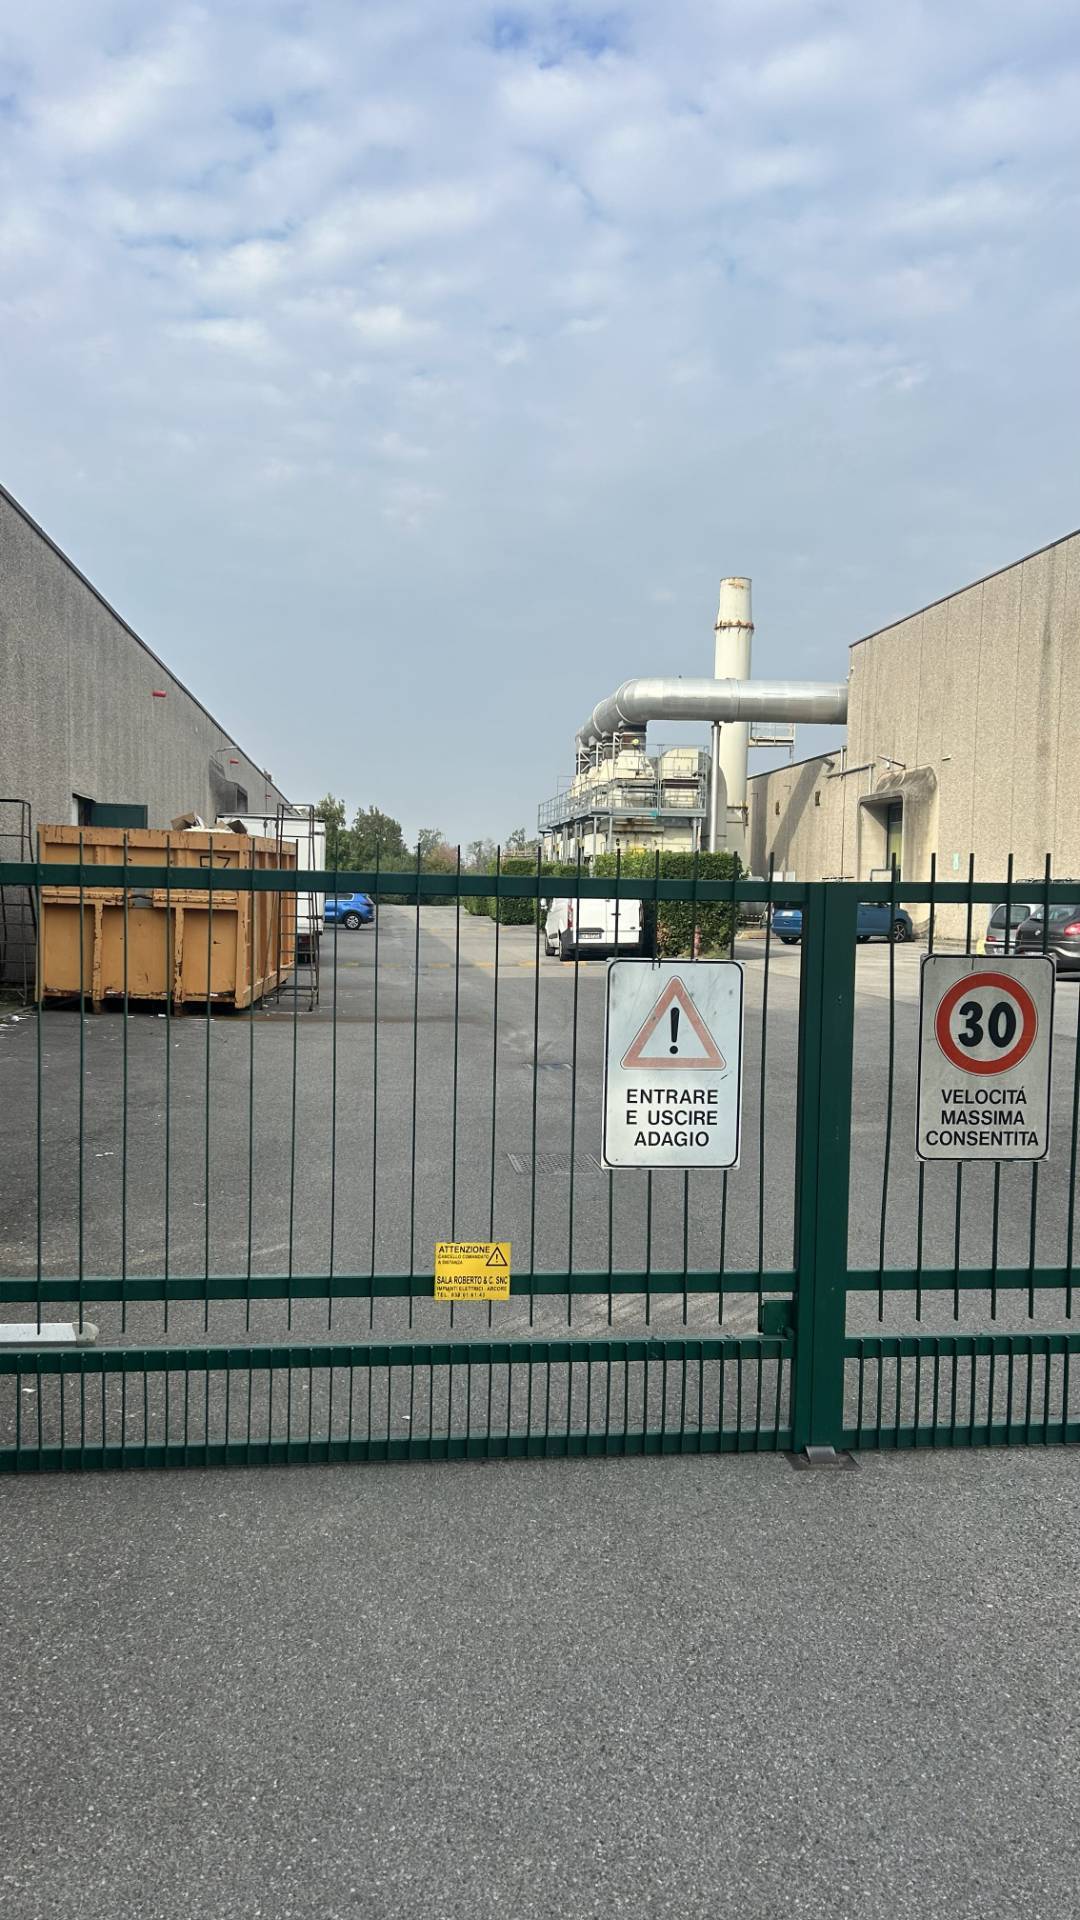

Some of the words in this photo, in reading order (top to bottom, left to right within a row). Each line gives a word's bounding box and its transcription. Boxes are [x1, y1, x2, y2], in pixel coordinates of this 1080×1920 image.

[957, 1000, 1017, 1048] 30
[626, 1089, 719, 1105] ENTRARE
[626, 1110, 637, 1125] E
[648, 1110, 718, 1125] USCIRE
[941, 1110, 1025, 1125] MASSIMA
[634, 1131, 710, 1147] ADAGIO
[926, 1130, 1039, 1146] CONSENTITA
[437, 1276, 452, 1285] SALA
[454, 1276, 482, 1285] ROBERTO
